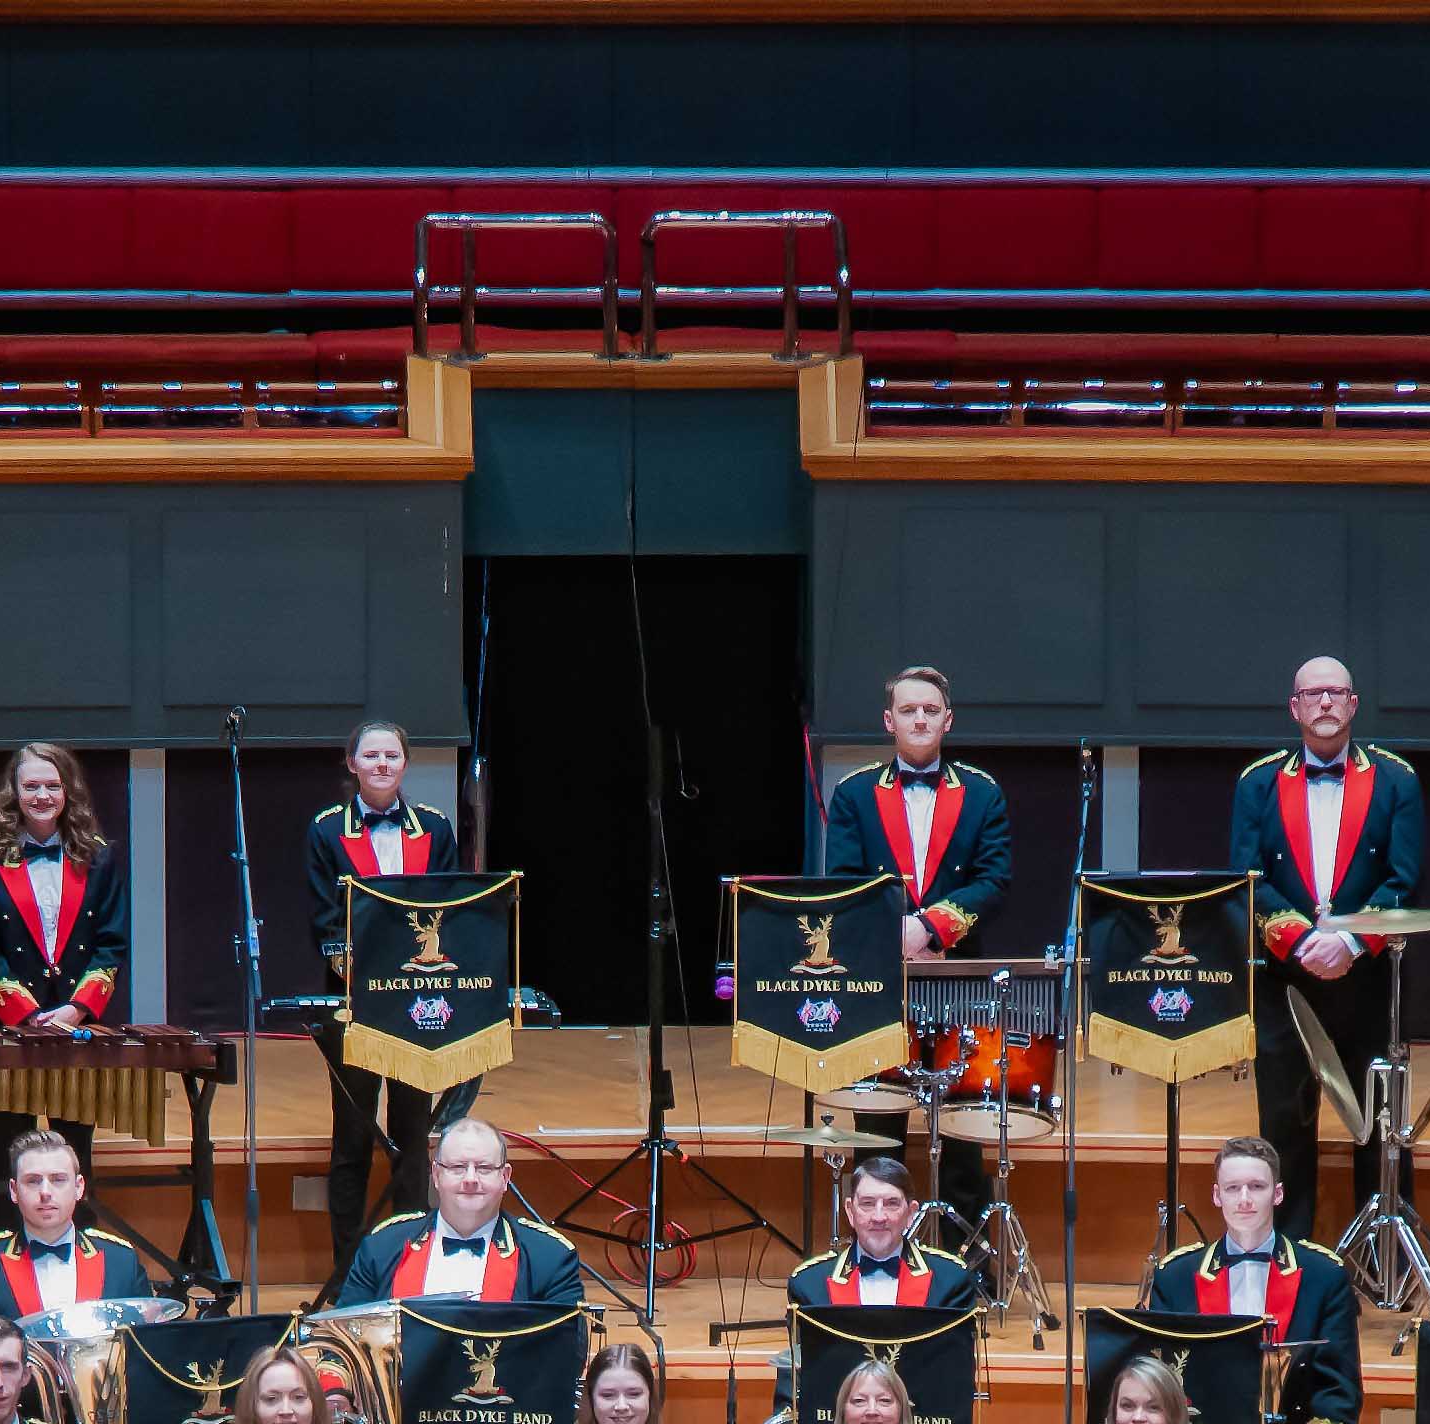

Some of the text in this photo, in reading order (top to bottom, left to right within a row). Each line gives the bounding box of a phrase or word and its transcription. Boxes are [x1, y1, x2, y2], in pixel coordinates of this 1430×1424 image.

[1109, 969, 1232, 983] BLACK DYKE BAND
[369, 977, 492, 990] BLACK DYKE BAND
[756, 980, 883, 992] BLACK DYKE BAND
[419, 1410, 552, 1424] BLACK DYKE BAND
